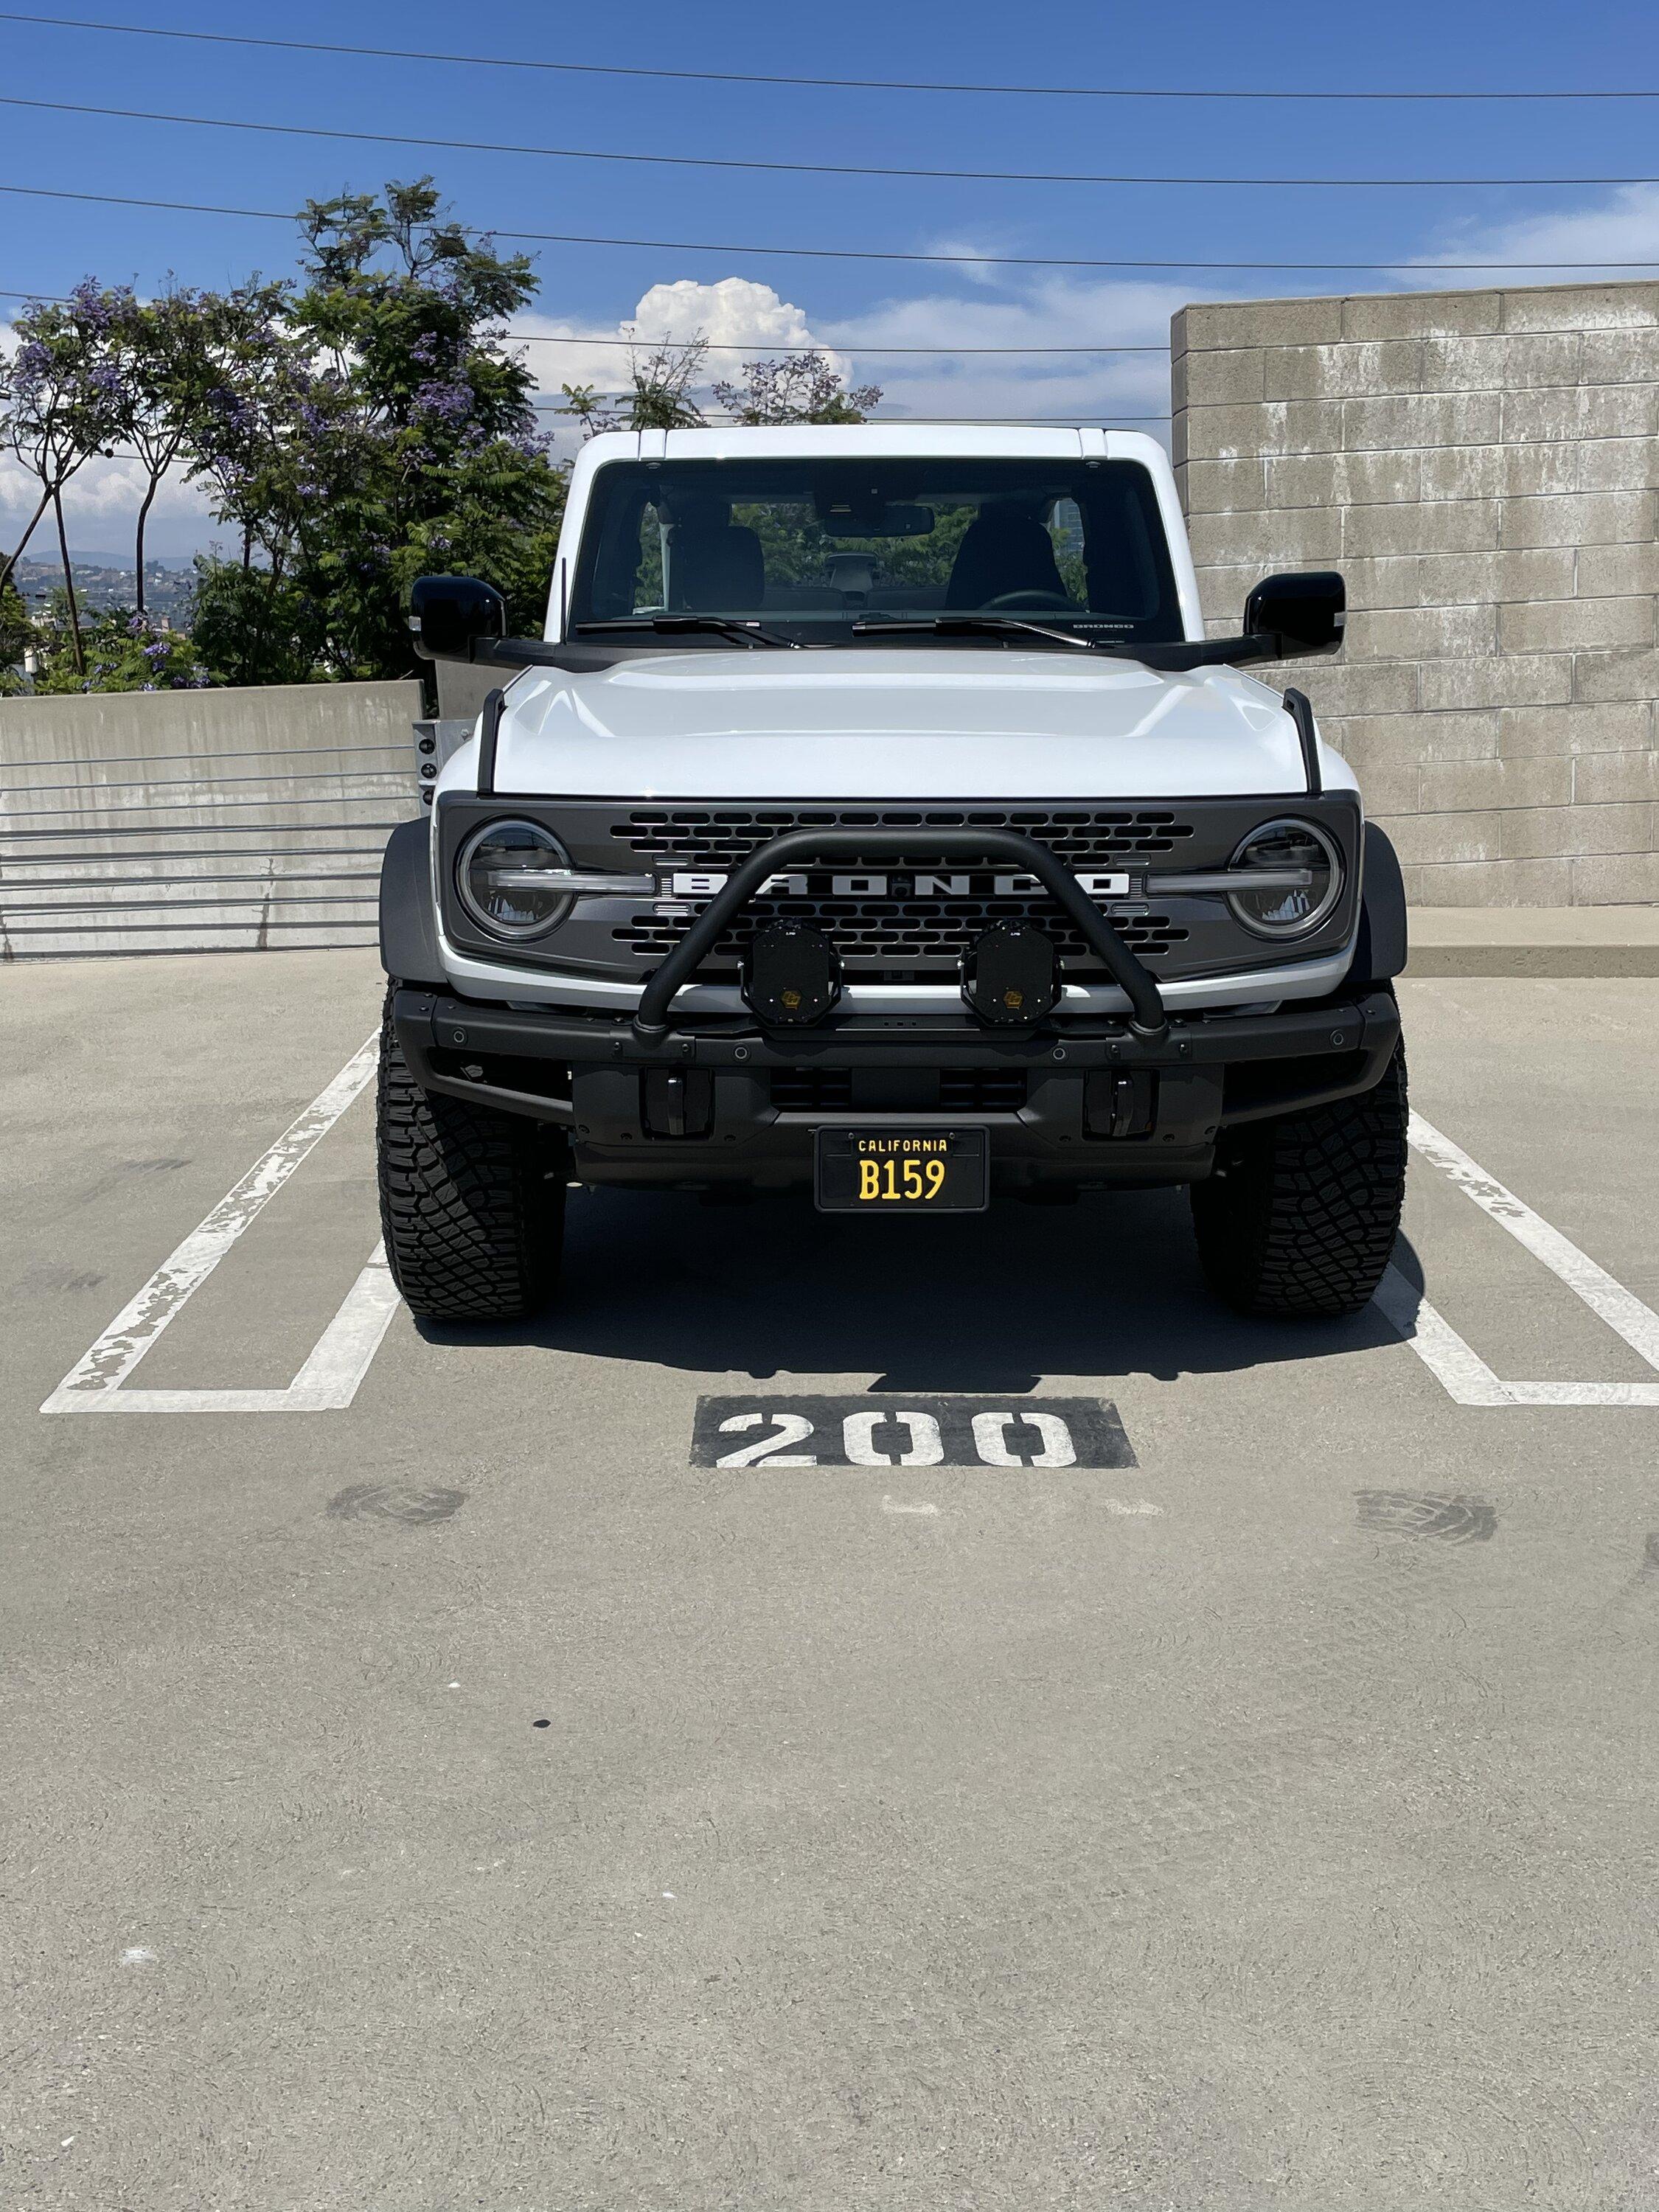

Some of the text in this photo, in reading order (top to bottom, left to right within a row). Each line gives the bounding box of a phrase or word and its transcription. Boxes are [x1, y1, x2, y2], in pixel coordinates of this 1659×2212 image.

[672, 873, 1130, 895] BRONCO
[858, 1139, 947, 1152] CALIFORNIA
[858, 1159, 946, 1200] B159
[715, 1410, 1078, 1467] 200
